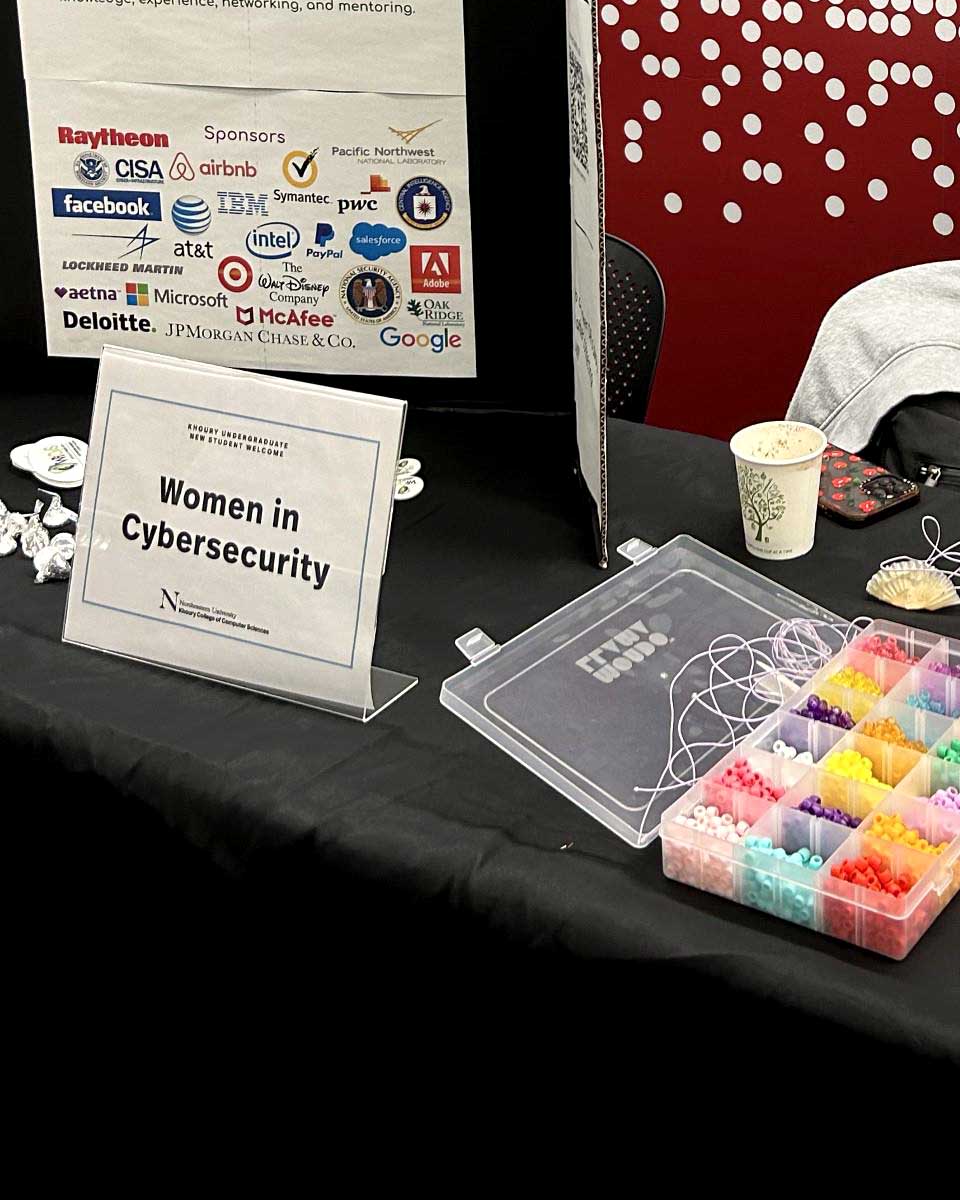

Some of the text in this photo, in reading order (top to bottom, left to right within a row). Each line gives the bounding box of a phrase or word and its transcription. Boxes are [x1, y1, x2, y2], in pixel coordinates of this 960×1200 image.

[306, 0, 333, 11] and
[339, 1, 415, 16] mentoring.
[58, 126, 169, 150] Raytheon
[204, 125, 286, 143] Sponsors
[331, 146, 436, 157] Pacific Northwest
[115, 158, 164, 180] CISA
[199, 159, 257, 178] airbnb
[64, 194, 151, 216] facebook
[217, 191, 269, 216] IBM
[273, 189, 330, 204] Symantec
[337, 199, 378, 214] pwc
[252, 229, 292, 249] intel
[355, 235, 401, 246] salesforce
[173, 240, 214, 259] at&t
[306, 248, 343, 260] PayPal
[62, 260, 184, 276] LOCKHEED MARTIN
[282, 262, 303, 273] The
[423, 278, 450, 289] Adobe
[69, 286, 118, 301] aetna
[154, 288, 229, 309] Microsoft
[269, 291, 319, 306] Company
[424, 299, 451, 310] OAK
[259, 308, 335, 328] McAfee
[424, 309, 464, 321] RIDGE
[257, 330, 309, 347] CHASE
[312, 333, 325, 347] &
[380, 327, 462, 353] Google
[187, 423, 289, 449] KHOURY UNDERGRADUATE
[189, 433, 284, 457] NEW STUDENT WELCOME
[160, 475, 300, 533] Women in
[121, 513, 330, 591] Cybersecurity
